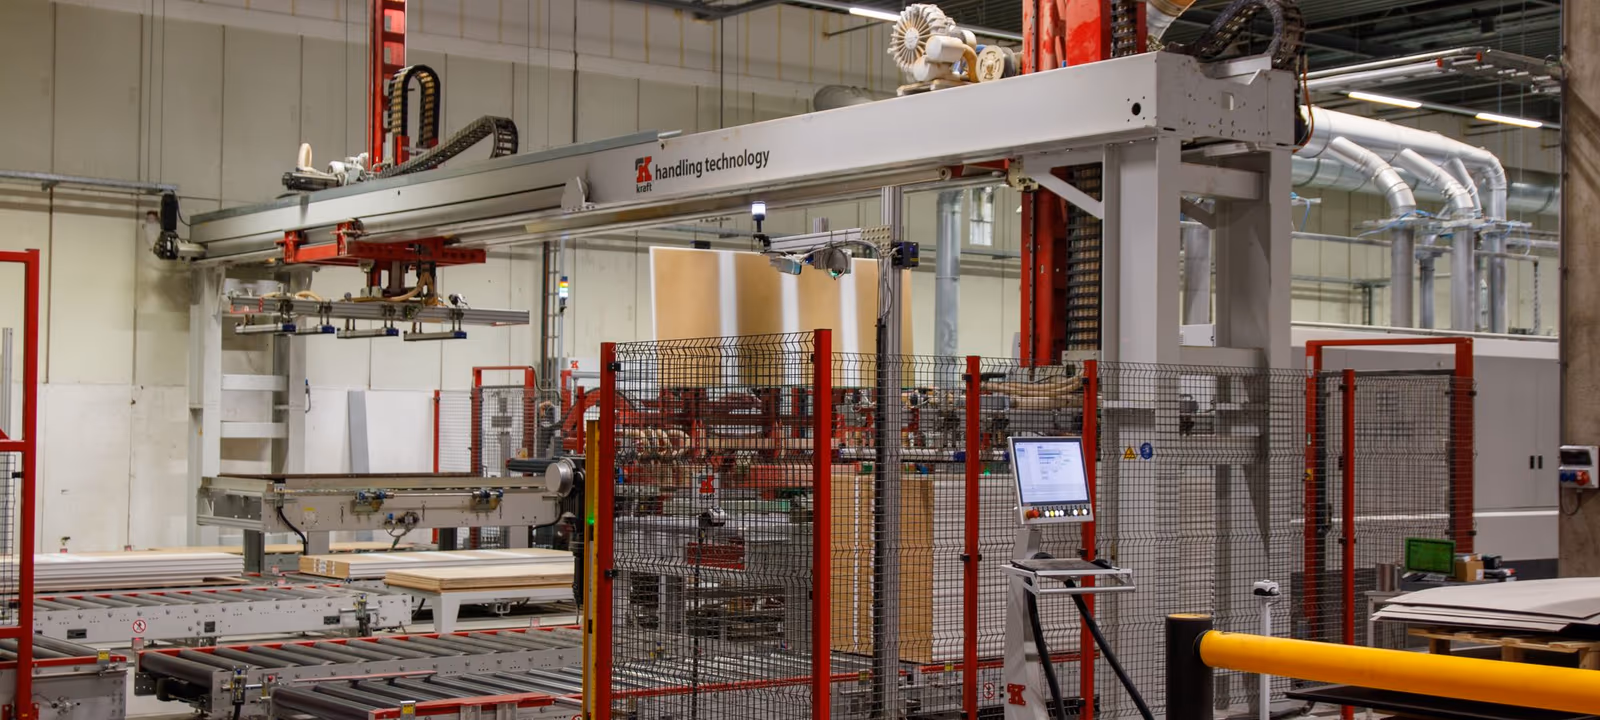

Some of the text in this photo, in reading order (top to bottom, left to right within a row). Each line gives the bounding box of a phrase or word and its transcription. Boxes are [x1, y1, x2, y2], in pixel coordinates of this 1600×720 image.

[655, 148, 770, 181] handling technology
[636, 182, 652, 193] kraft
